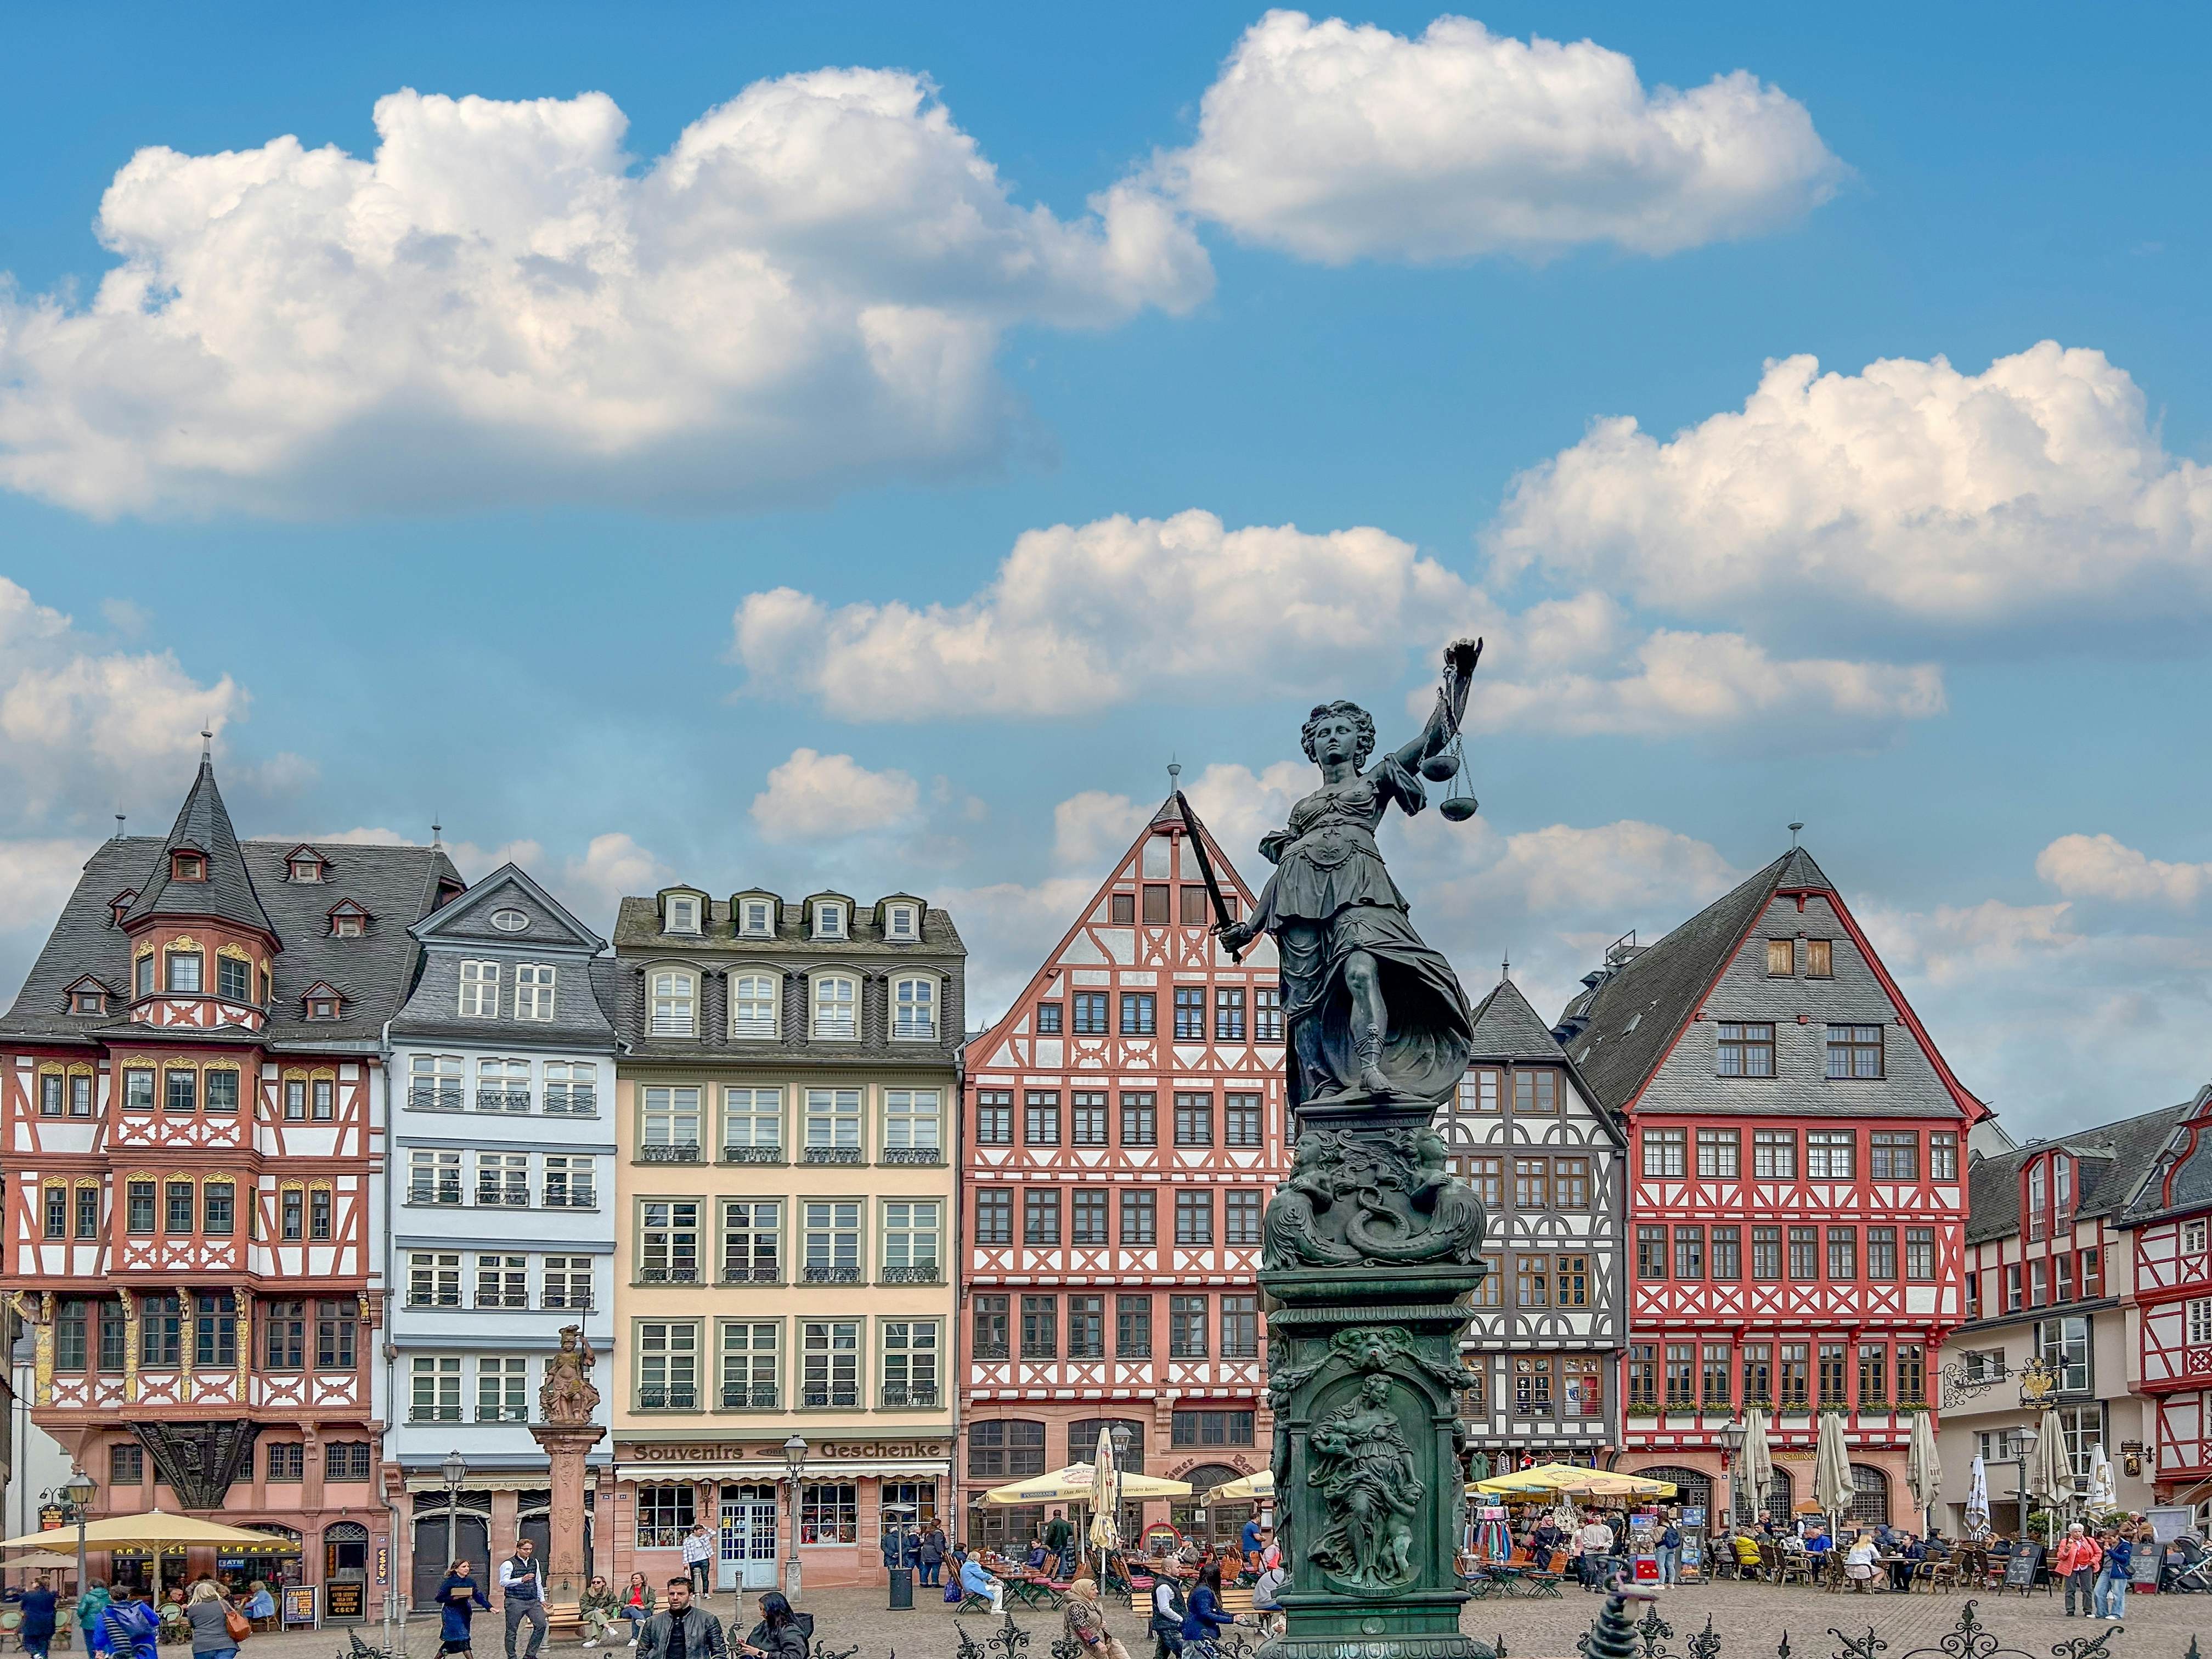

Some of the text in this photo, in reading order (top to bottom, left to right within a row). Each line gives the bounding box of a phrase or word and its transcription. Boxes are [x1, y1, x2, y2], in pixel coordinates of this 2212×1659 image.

[634, 1444, 743, 1460] Souvenirs
[821, 1442, 940, 1457] Geschenke
[1163, 1458, 1195, 1480] ömer
